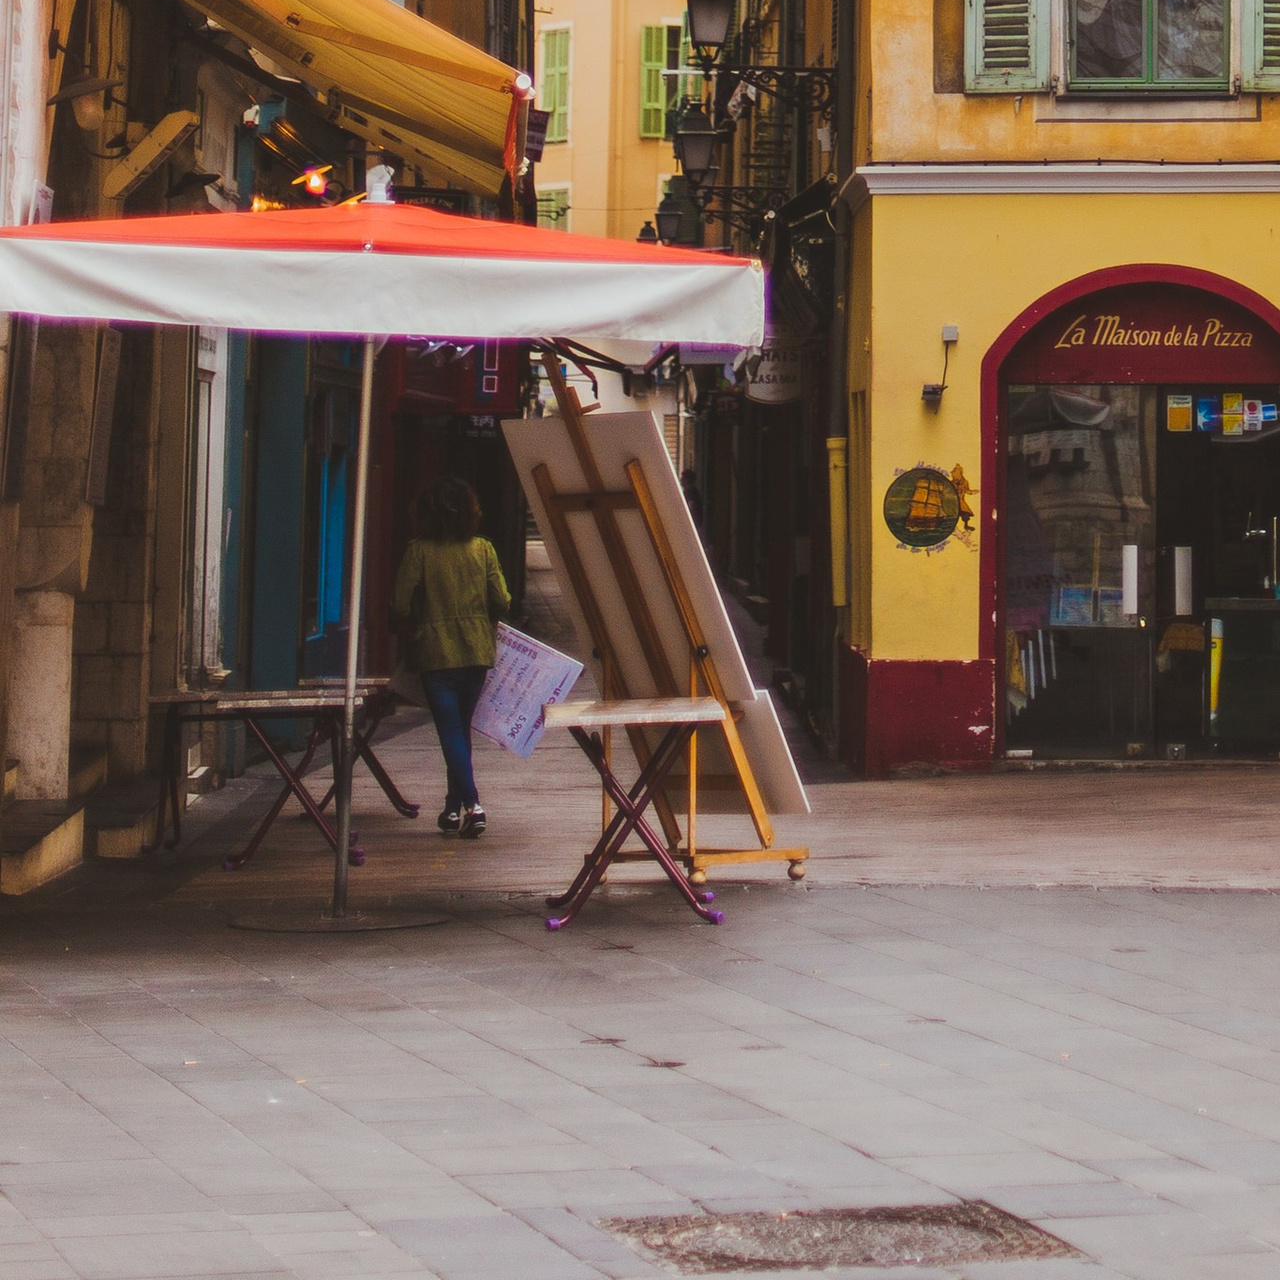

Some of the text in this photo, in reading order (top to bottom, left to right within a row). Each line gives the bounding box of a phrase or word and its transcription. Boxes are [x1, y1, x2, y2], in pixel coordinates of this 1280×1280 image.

[1054, 314, 1254, 349] La Maison de la Pizza
[495, 632, 539, 660] DESSERTS
[506, 714, 527, 740] 5,90€
